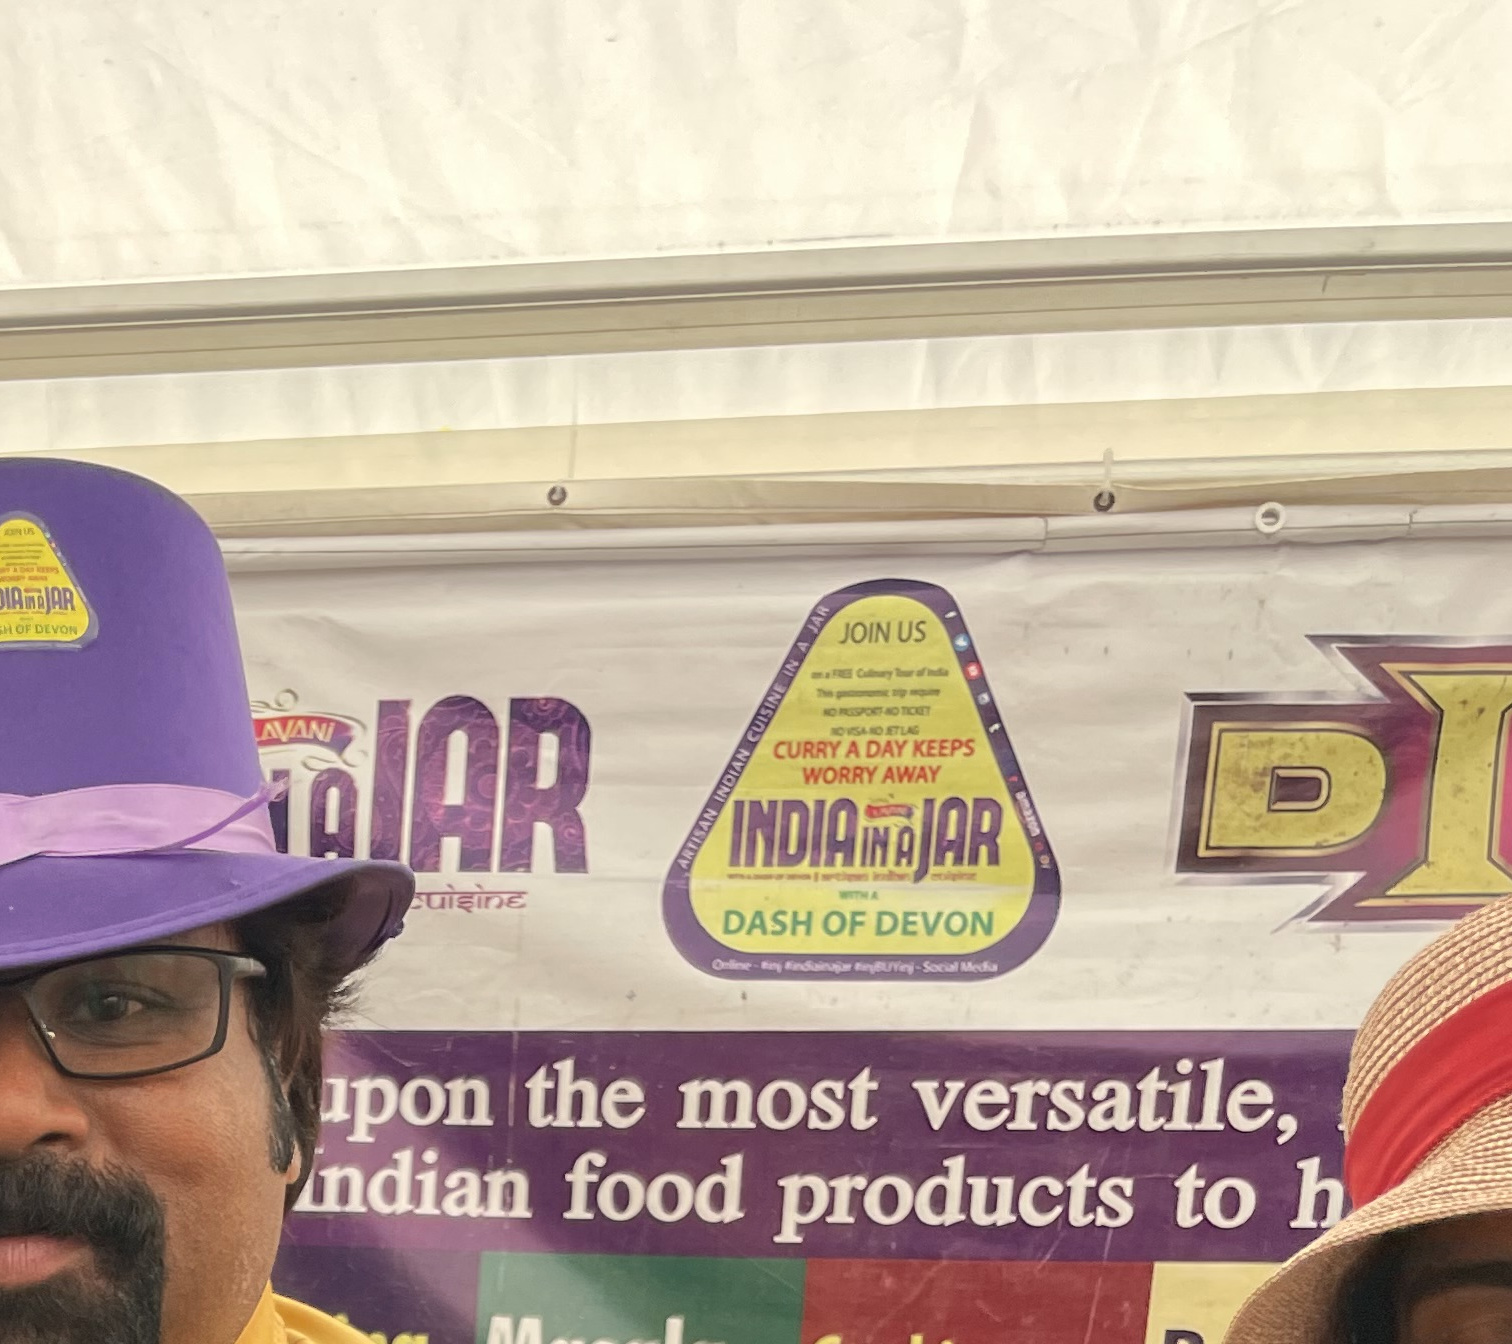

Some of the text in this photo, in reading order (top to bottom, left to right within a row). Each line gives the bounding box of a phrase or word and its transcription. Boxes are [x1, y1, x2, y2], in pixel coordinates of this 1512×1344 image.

[45, 586, 76, 614] JAR
[15, 624, 31, 635] OF
[35, 623, 78, 635] DEVON
[839, 621, 927, 644] JOIN US
[832, 669, 853, 679] FREE
[713, 747, 751, 804] INDIAN
[746, 681, 786, 744] CUISINE
[773, 738, 976, 761] CURRY A DAY KEEPS
[370, 695, 592, 875] JAR
[802, 765, 943, 785] WORRY AWAY
[728, 797, 1005, 884] INDIA IN A JAR
[838, 890, 879, 900] WITH A
[723, 910, 995, 938] DASH OF DEVON
[320, 1058, 1298, 1146] upon the most versatile,
[562, 1153, 745, 1224] food
[773, 1160, 1136, 1244] products
[1174, 1163, 1257, 1229] to
